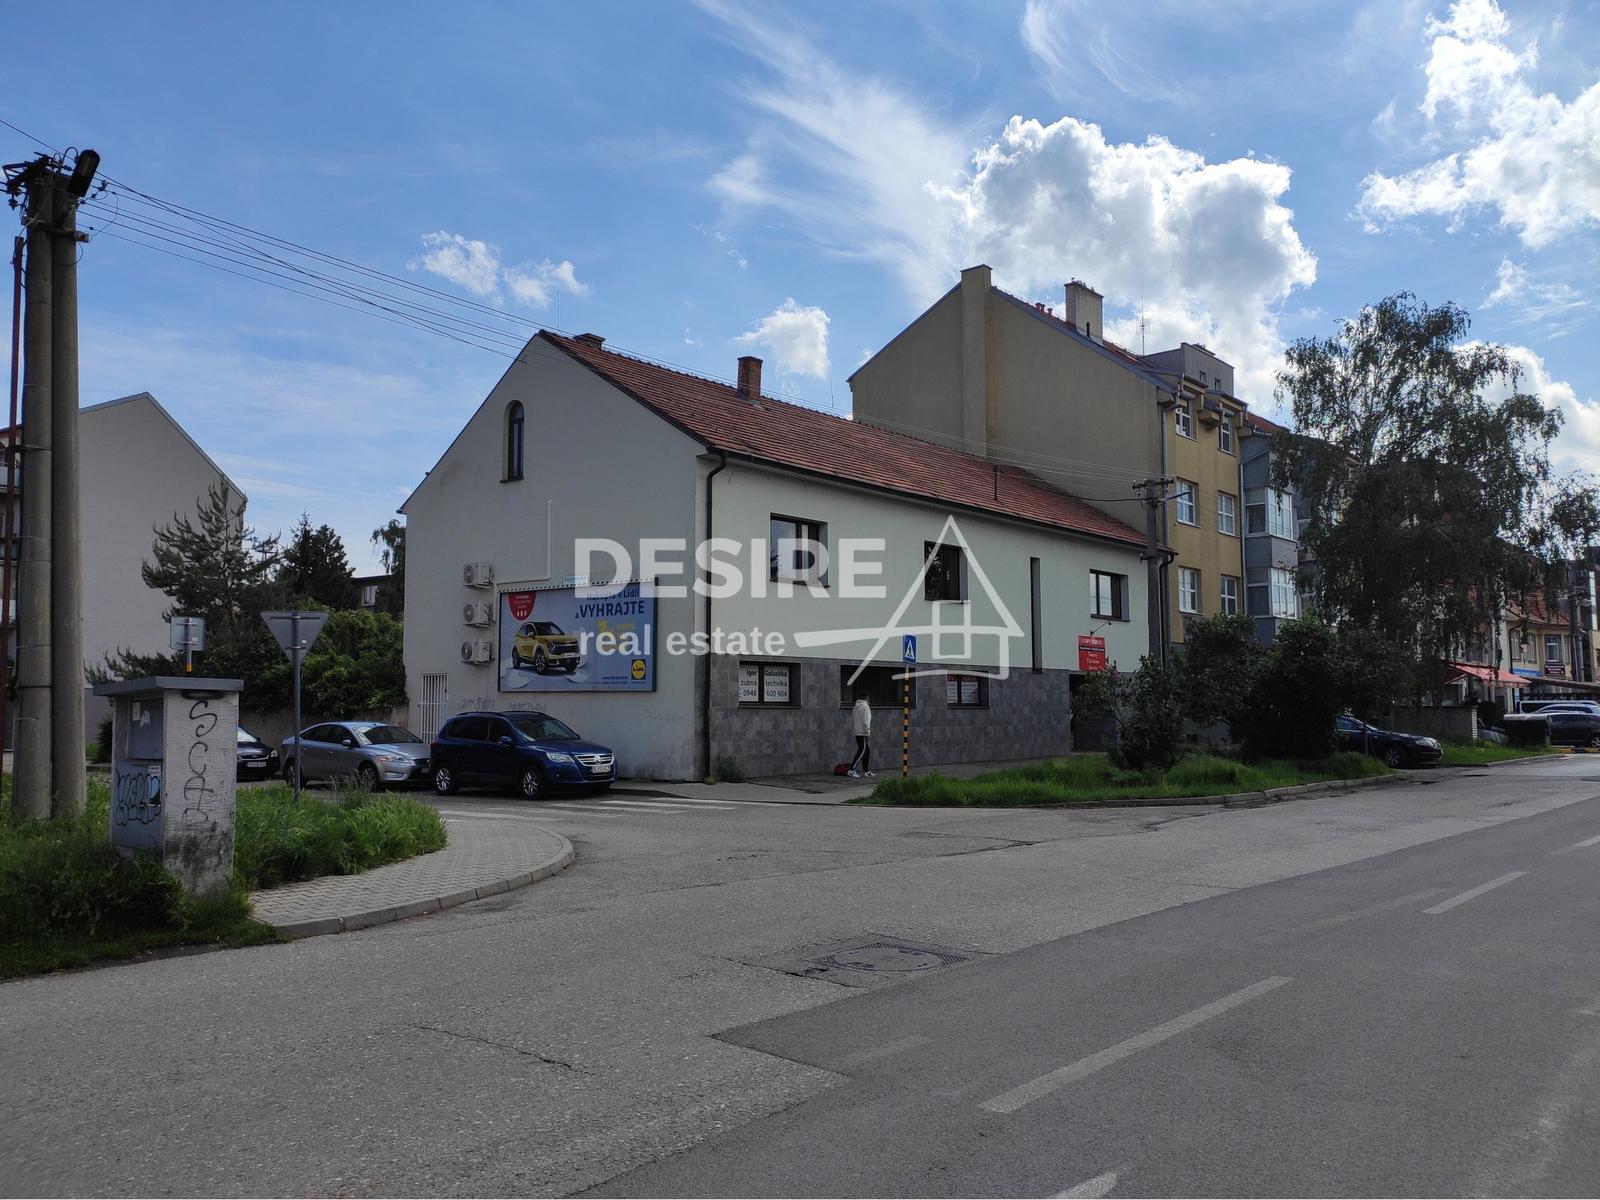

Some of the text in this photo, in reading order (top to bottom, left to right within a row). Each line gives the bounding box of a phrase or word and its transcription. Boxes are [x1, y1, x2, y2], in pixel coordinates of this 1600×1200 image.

[579, 600, 645, 618] VYHRAJTE
[746, 668, 757, 678] Igor
[765, 679, 788, 687] technika
[743, 689, 757, 697] 0948
